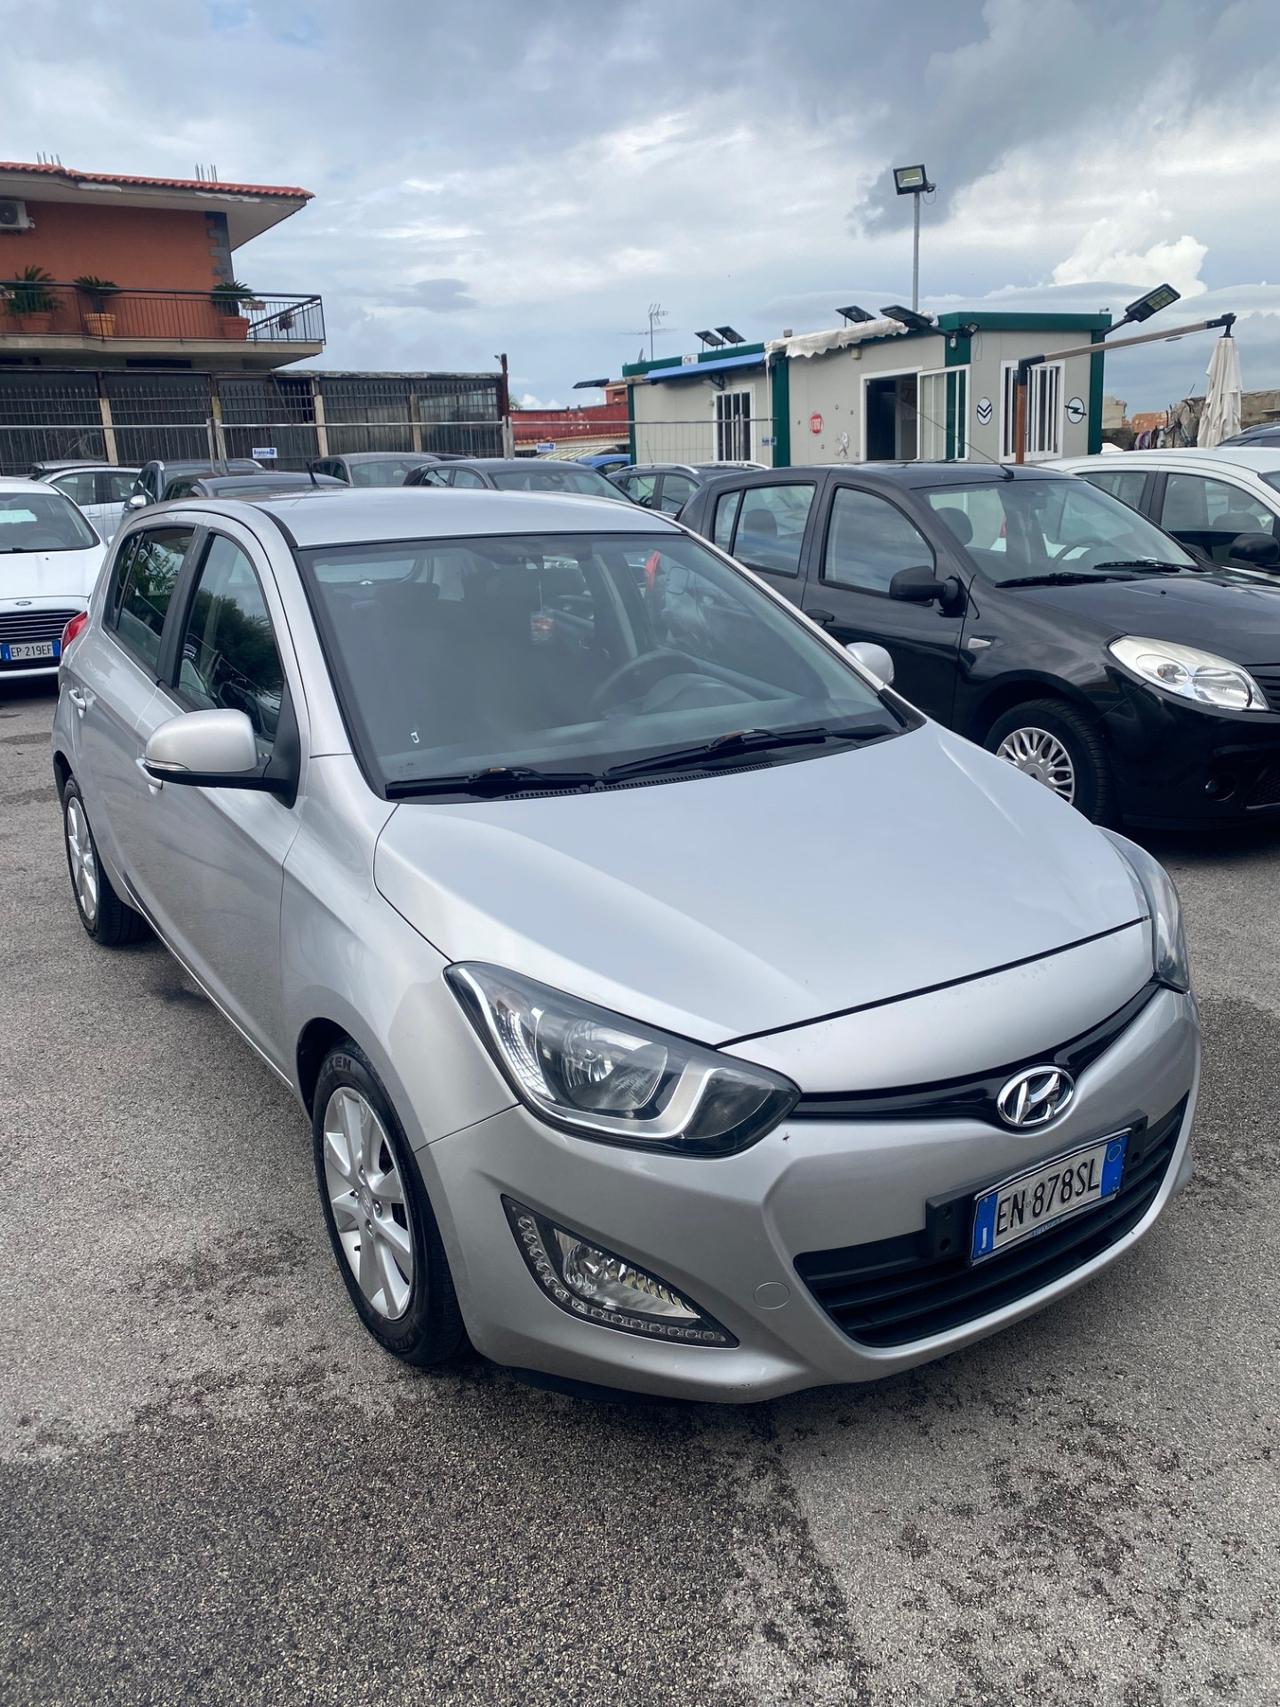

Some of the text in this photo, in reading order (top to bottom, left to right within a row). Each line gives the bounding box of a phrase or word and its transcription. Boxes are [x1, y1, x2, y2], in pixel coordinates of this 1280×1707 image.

[10, 644, 52, 658] EP 219EF
[996, 1158, 1100, 1236] EN 878SL
